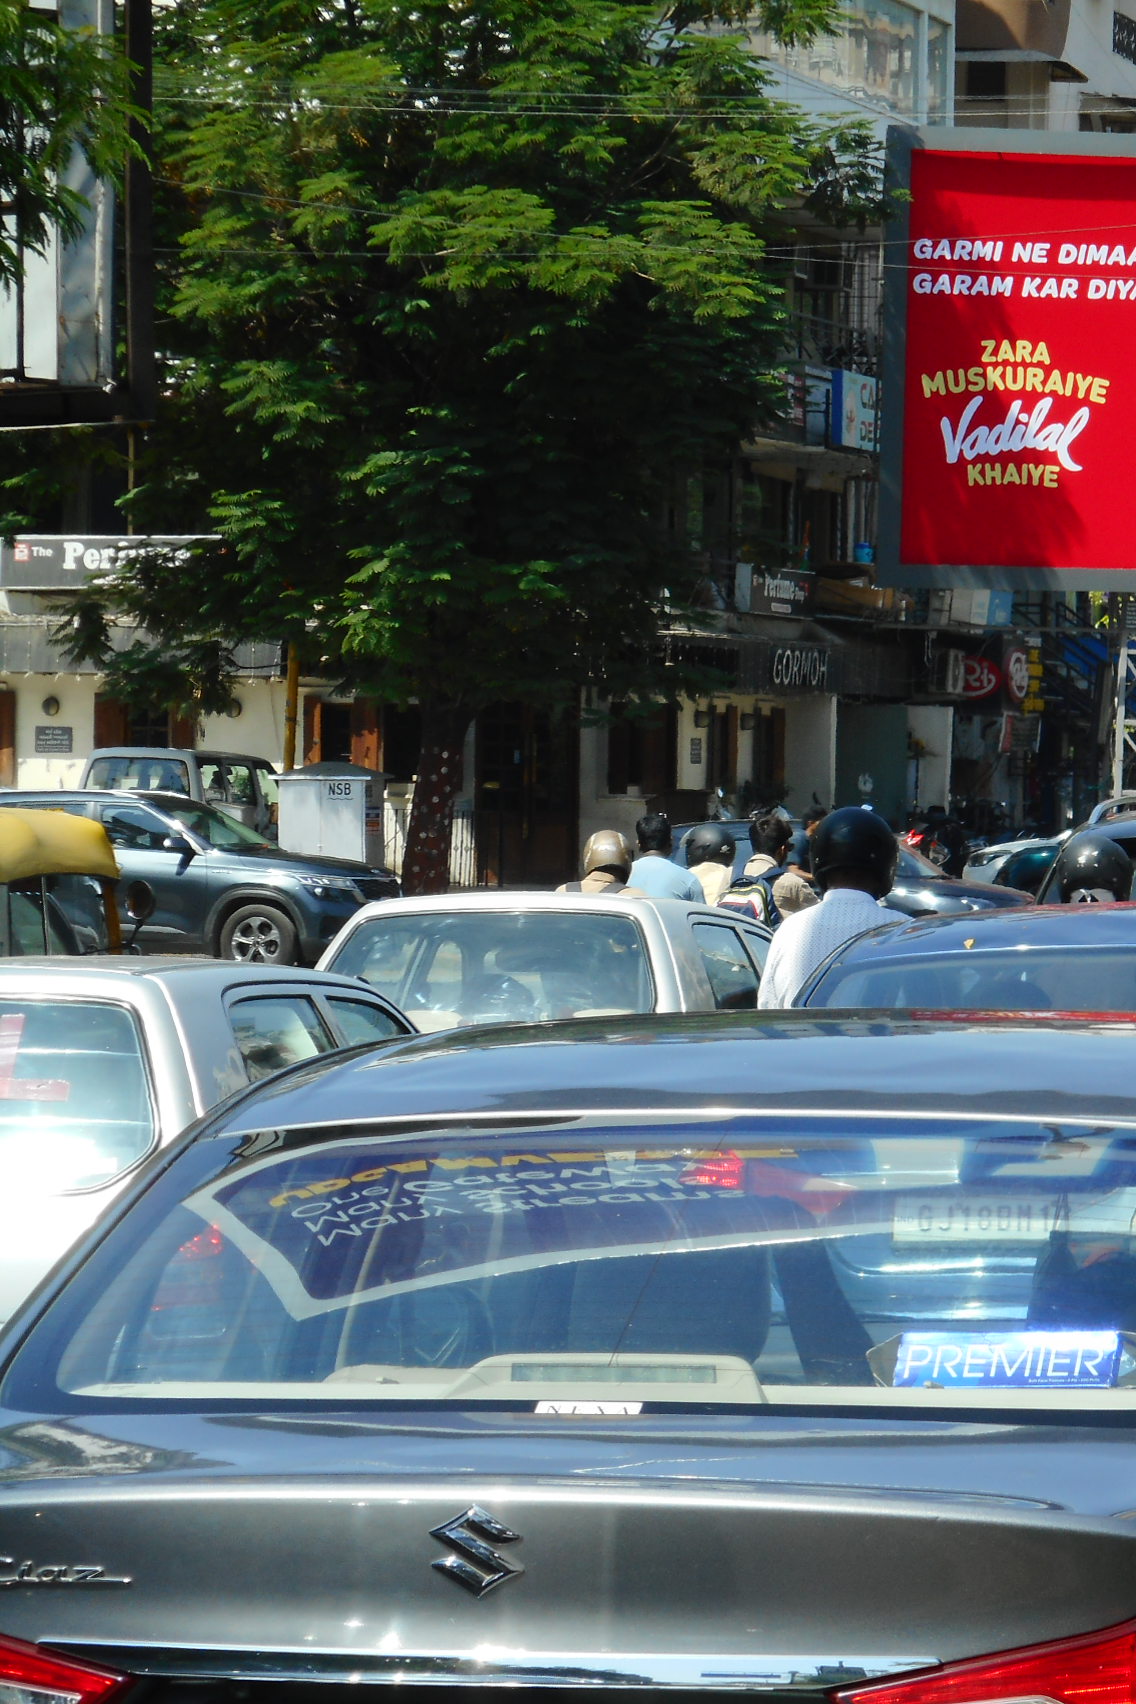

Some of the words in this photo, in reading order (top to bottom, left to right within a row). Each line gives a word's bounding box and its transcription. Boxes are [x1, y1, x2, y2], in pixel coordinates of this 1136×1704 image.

[913, 238, 1003, 262] GARMI
[1011, 241, 1050, 264] NE
[912, 273, 1014, 297] GARAM
[1021, 276, 1079, 300] KAR
[981, 339, 1050, 366] ZARA
[921, 365, 1111, 405] MUSKURAIYE
[940, 395, 1091, 472] Vadilal
[967, 463, 1060, 488] KHAIYE
[32, 546, 53, 557] The
[773, 649, 829, 686] GORMOH
[328, 782, 352, 796] NSB
[903, 1344, 1104, 1379] PREMIER
